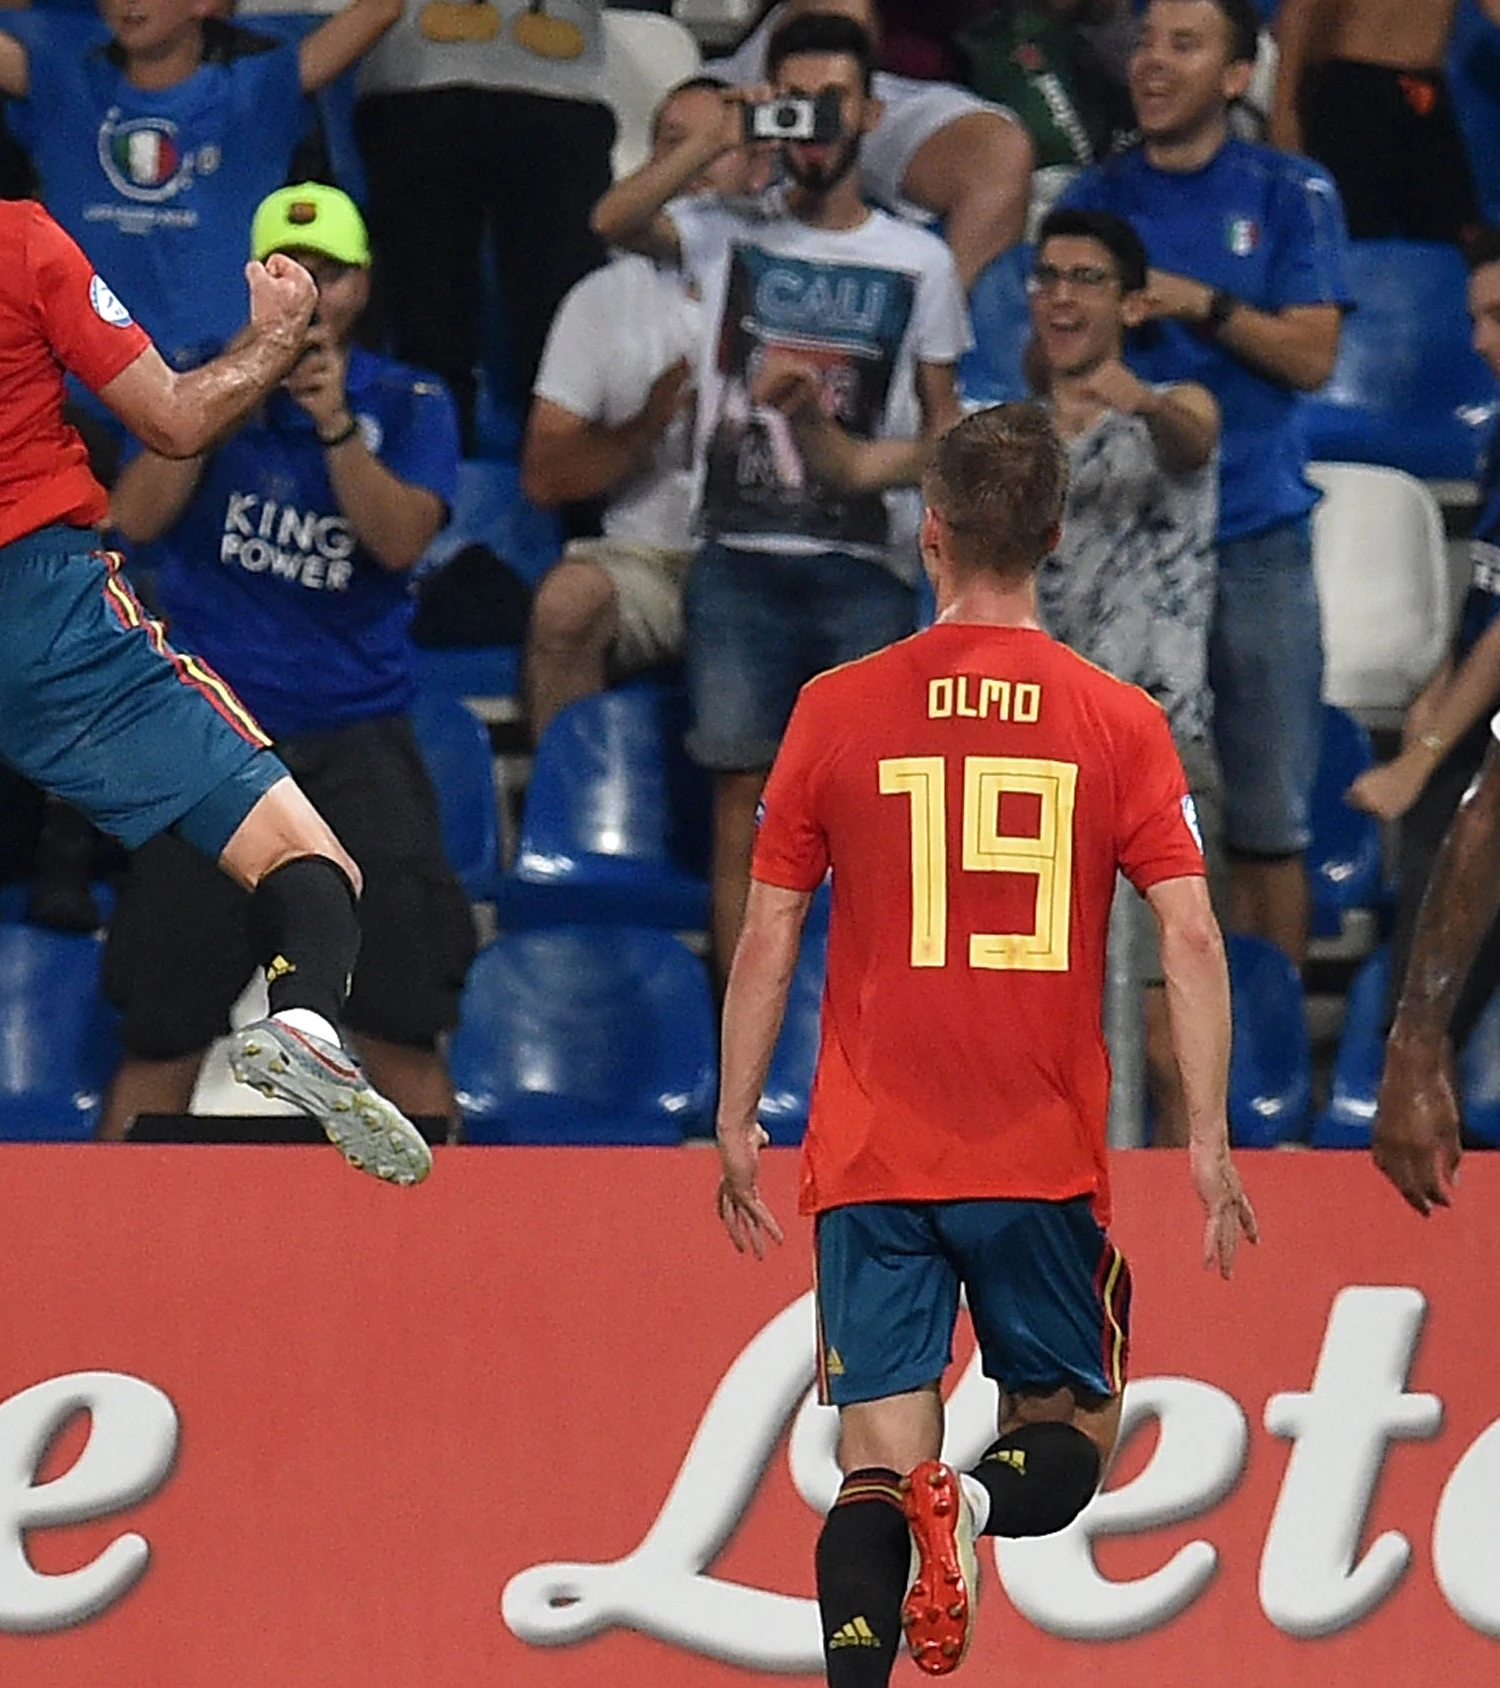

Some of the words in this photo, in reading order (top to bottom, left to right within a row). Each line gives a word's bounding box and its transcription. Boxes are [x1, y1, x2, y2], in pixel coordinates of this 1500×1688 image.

[755, 267, 889, 330] CALI
[225, 491, 357, 560] KING
[220, 532, 354, 591] POWER
[928, 676, 1041, 723] OLMO
[878, 756, 1079, 972] 19
